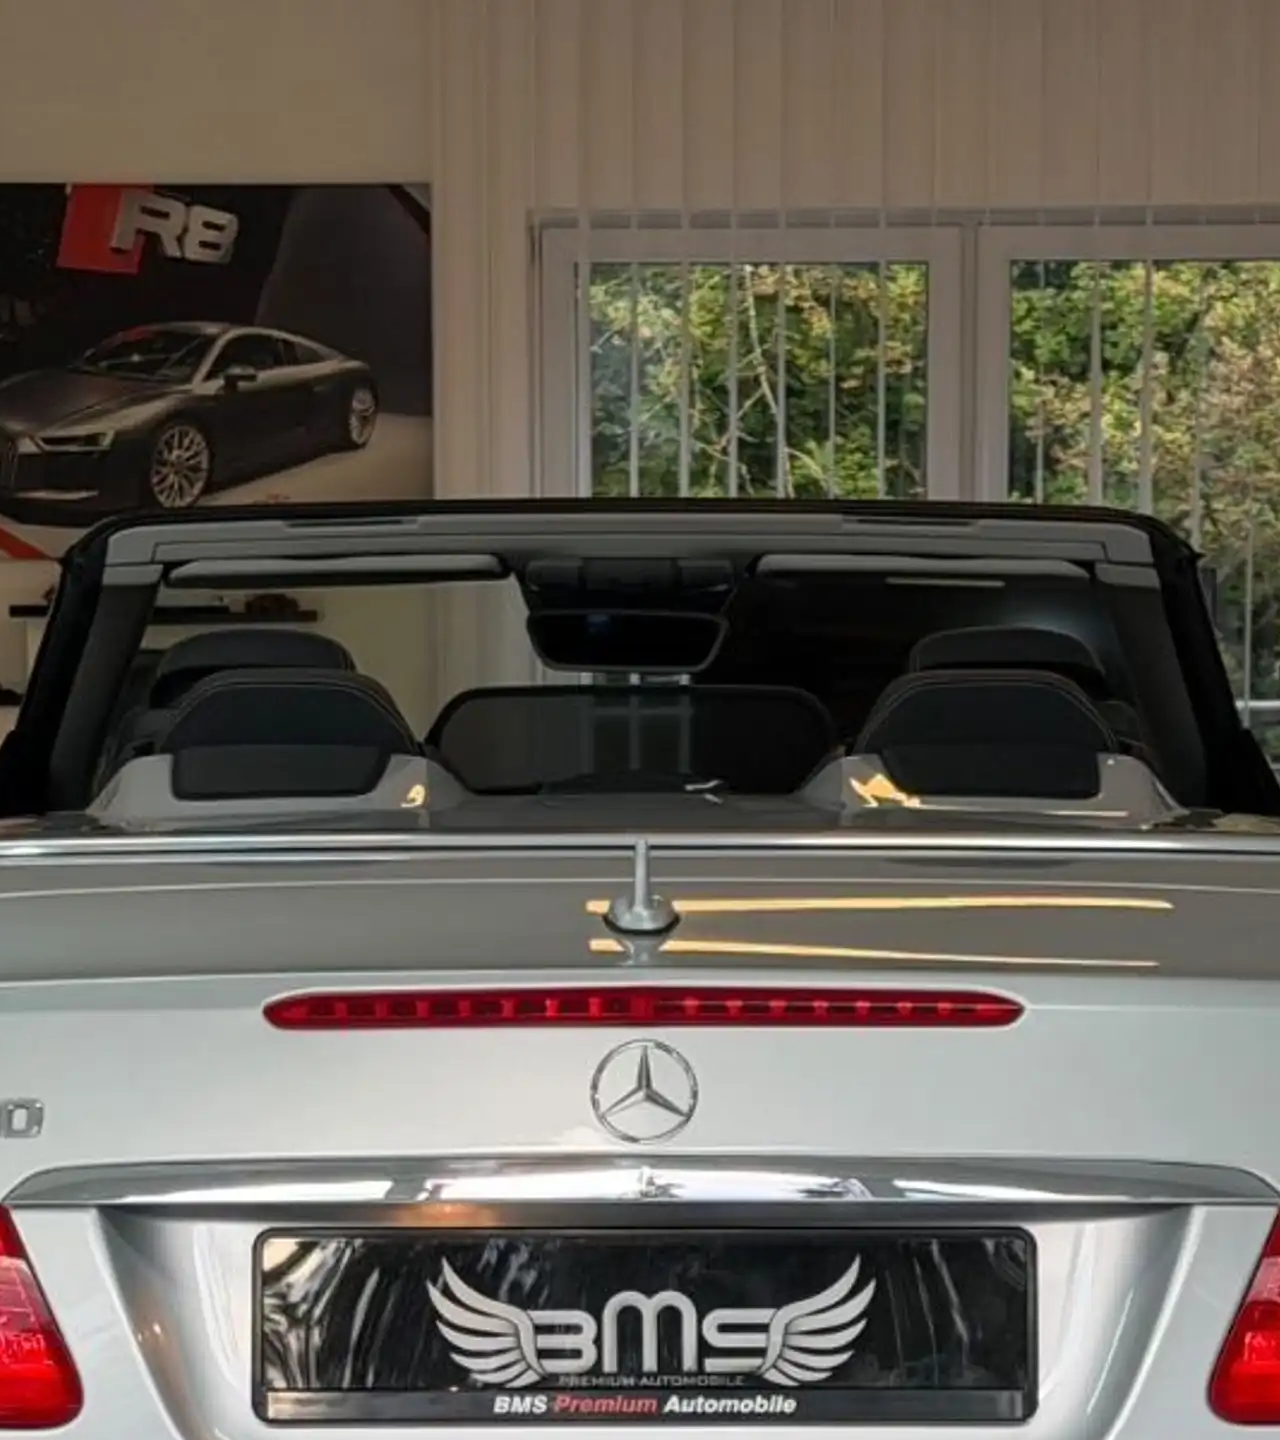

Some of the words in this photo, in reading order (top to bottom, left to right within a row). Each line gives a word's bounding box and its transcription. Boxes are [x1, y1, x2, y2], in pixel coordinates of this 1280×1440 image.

[110, 186, 239, 264] R8
[528, 1290, 778, 1374] BMS
[493, 1394, 548, 1414] BMS
[554, 1394, 658, 1414] Premium
[662, 1394, 798, 1414] Automobile
